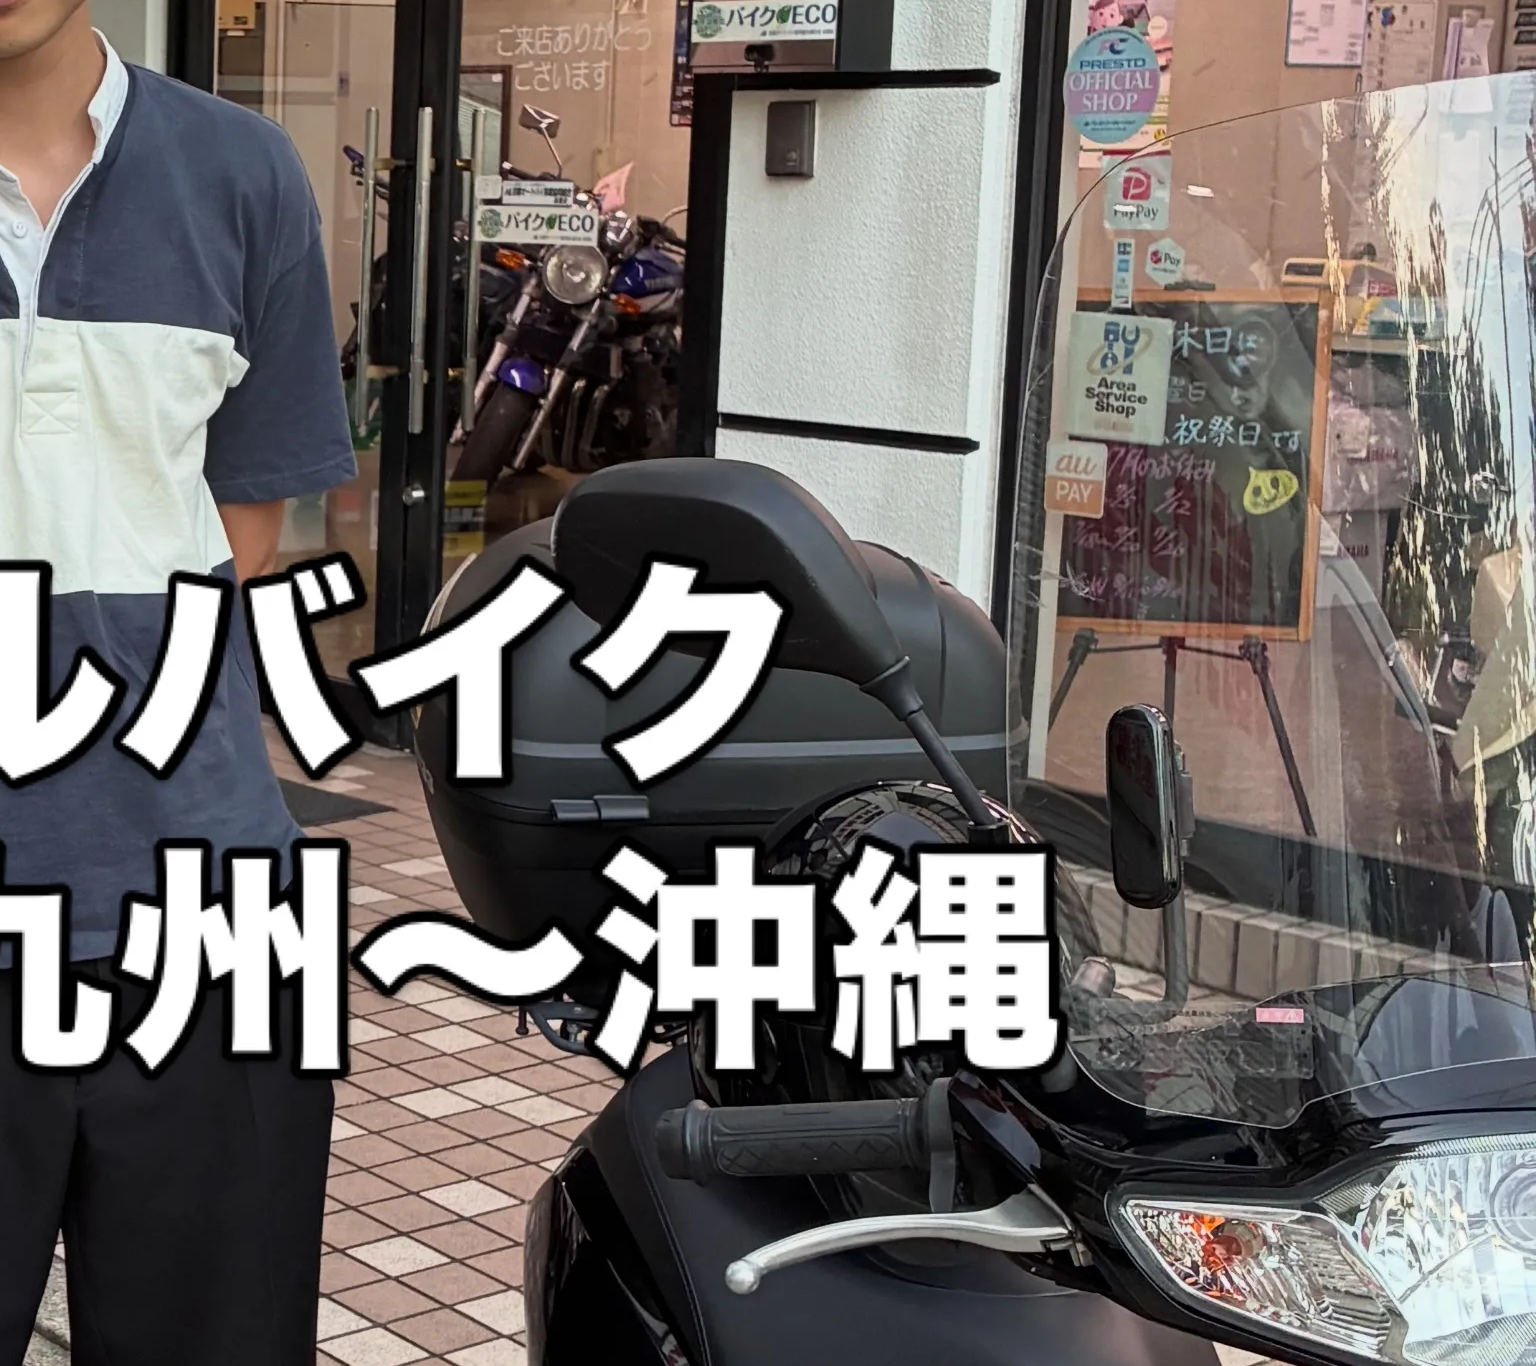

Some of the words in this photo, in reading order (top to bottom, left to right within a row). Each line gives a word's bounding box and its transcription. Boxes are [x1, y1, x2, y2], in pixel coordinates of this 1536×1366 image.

[791, 3, 837, 25] ECO
[497, 21, 652, 56] ご来店ありがとう
[1079, 57, 1146, 70] PRESTO
[514, 60, 611, 91] ございます
[1070, 70, 1154, 91] OFFICIAL
[1082, 91, 1138, 111] SHOP
[557, 214, 595, 233] ECO
[1097, 376, 1137, 392] Area
[1085, 386, 1148, 405] Service
[1095, 399, 1137, 419] Shop
[1055, 454, 1098, 477] au
[1056, 480, 1094, 504] PAY
